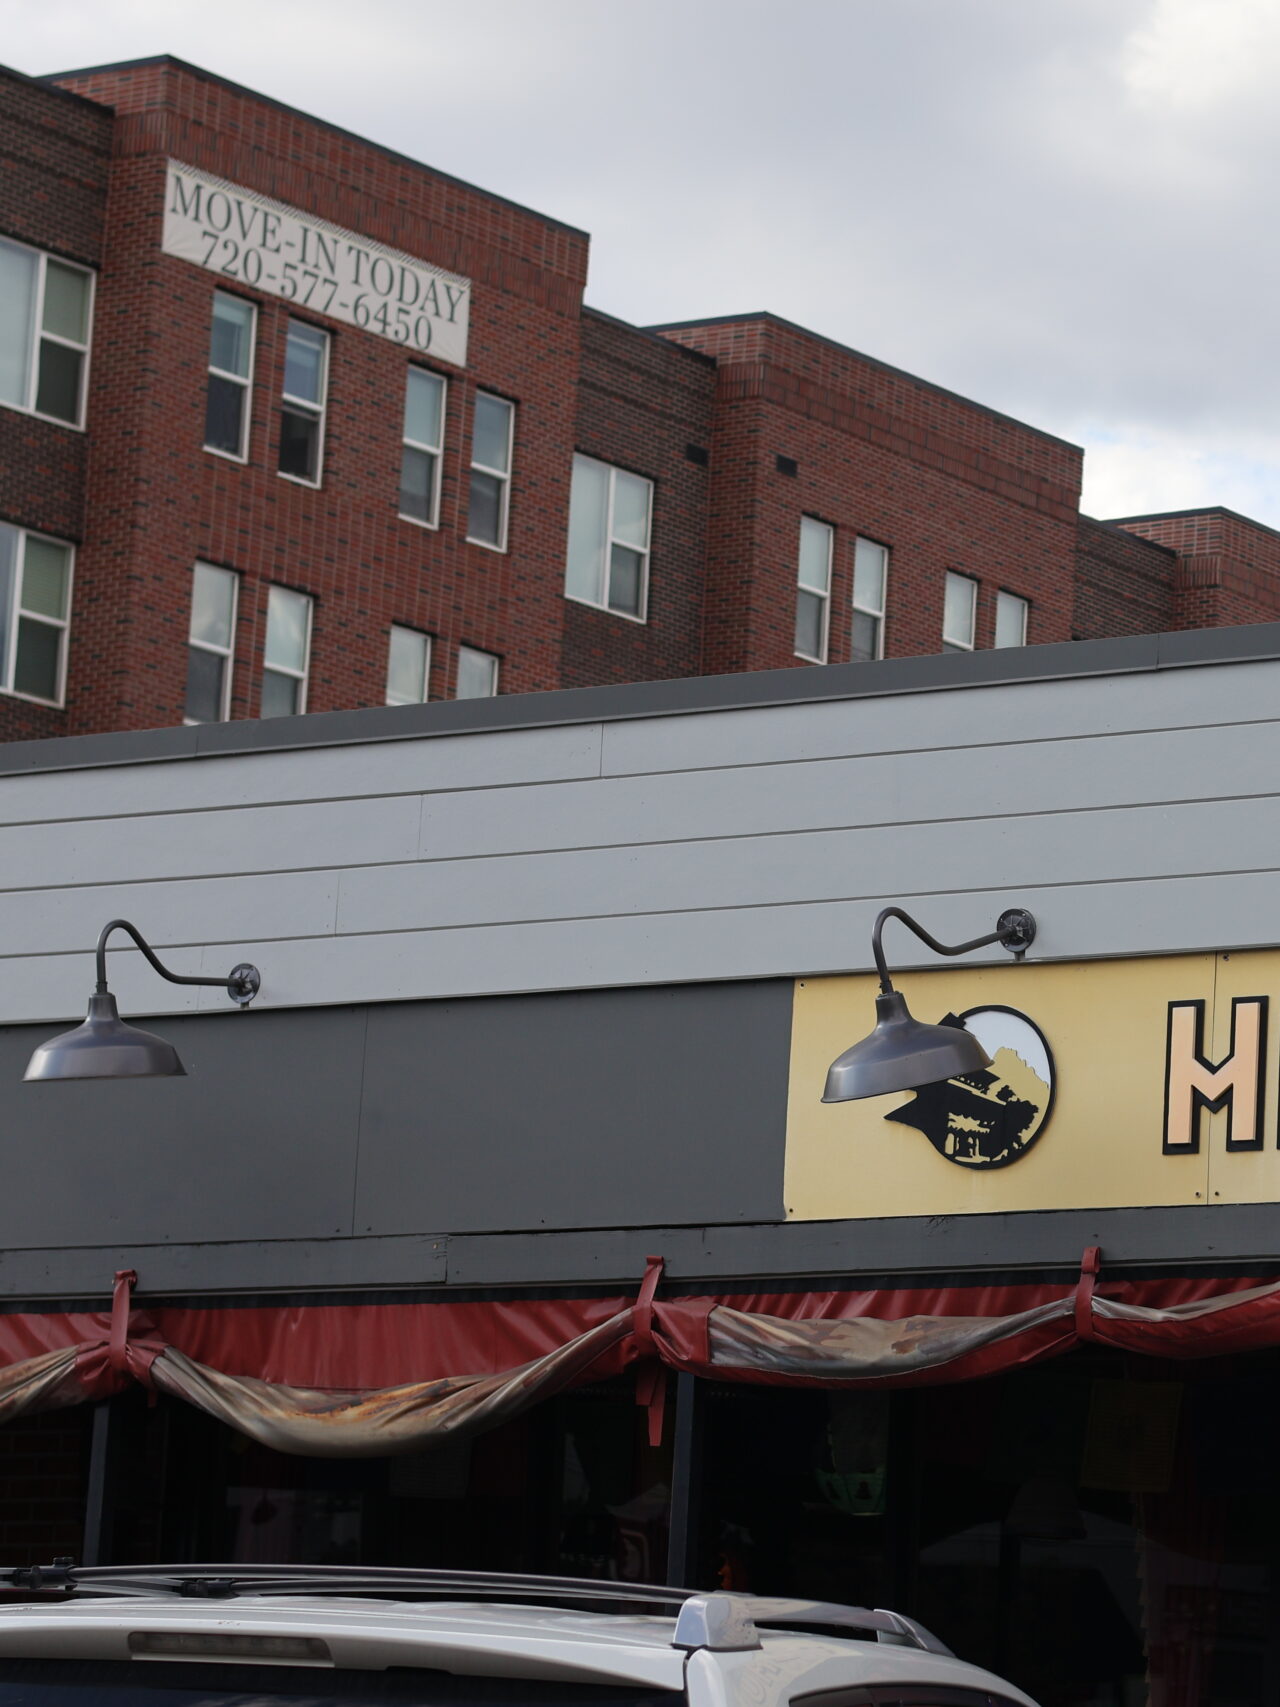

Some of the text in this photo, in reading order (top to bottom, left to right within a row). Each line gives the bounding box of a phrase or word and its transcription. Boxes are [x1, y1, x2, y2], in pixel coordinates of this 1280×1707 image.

[169, 174, 467, 324] MOVE-IN TODAY
[200, 229, 433, 351] 720-577-6450
